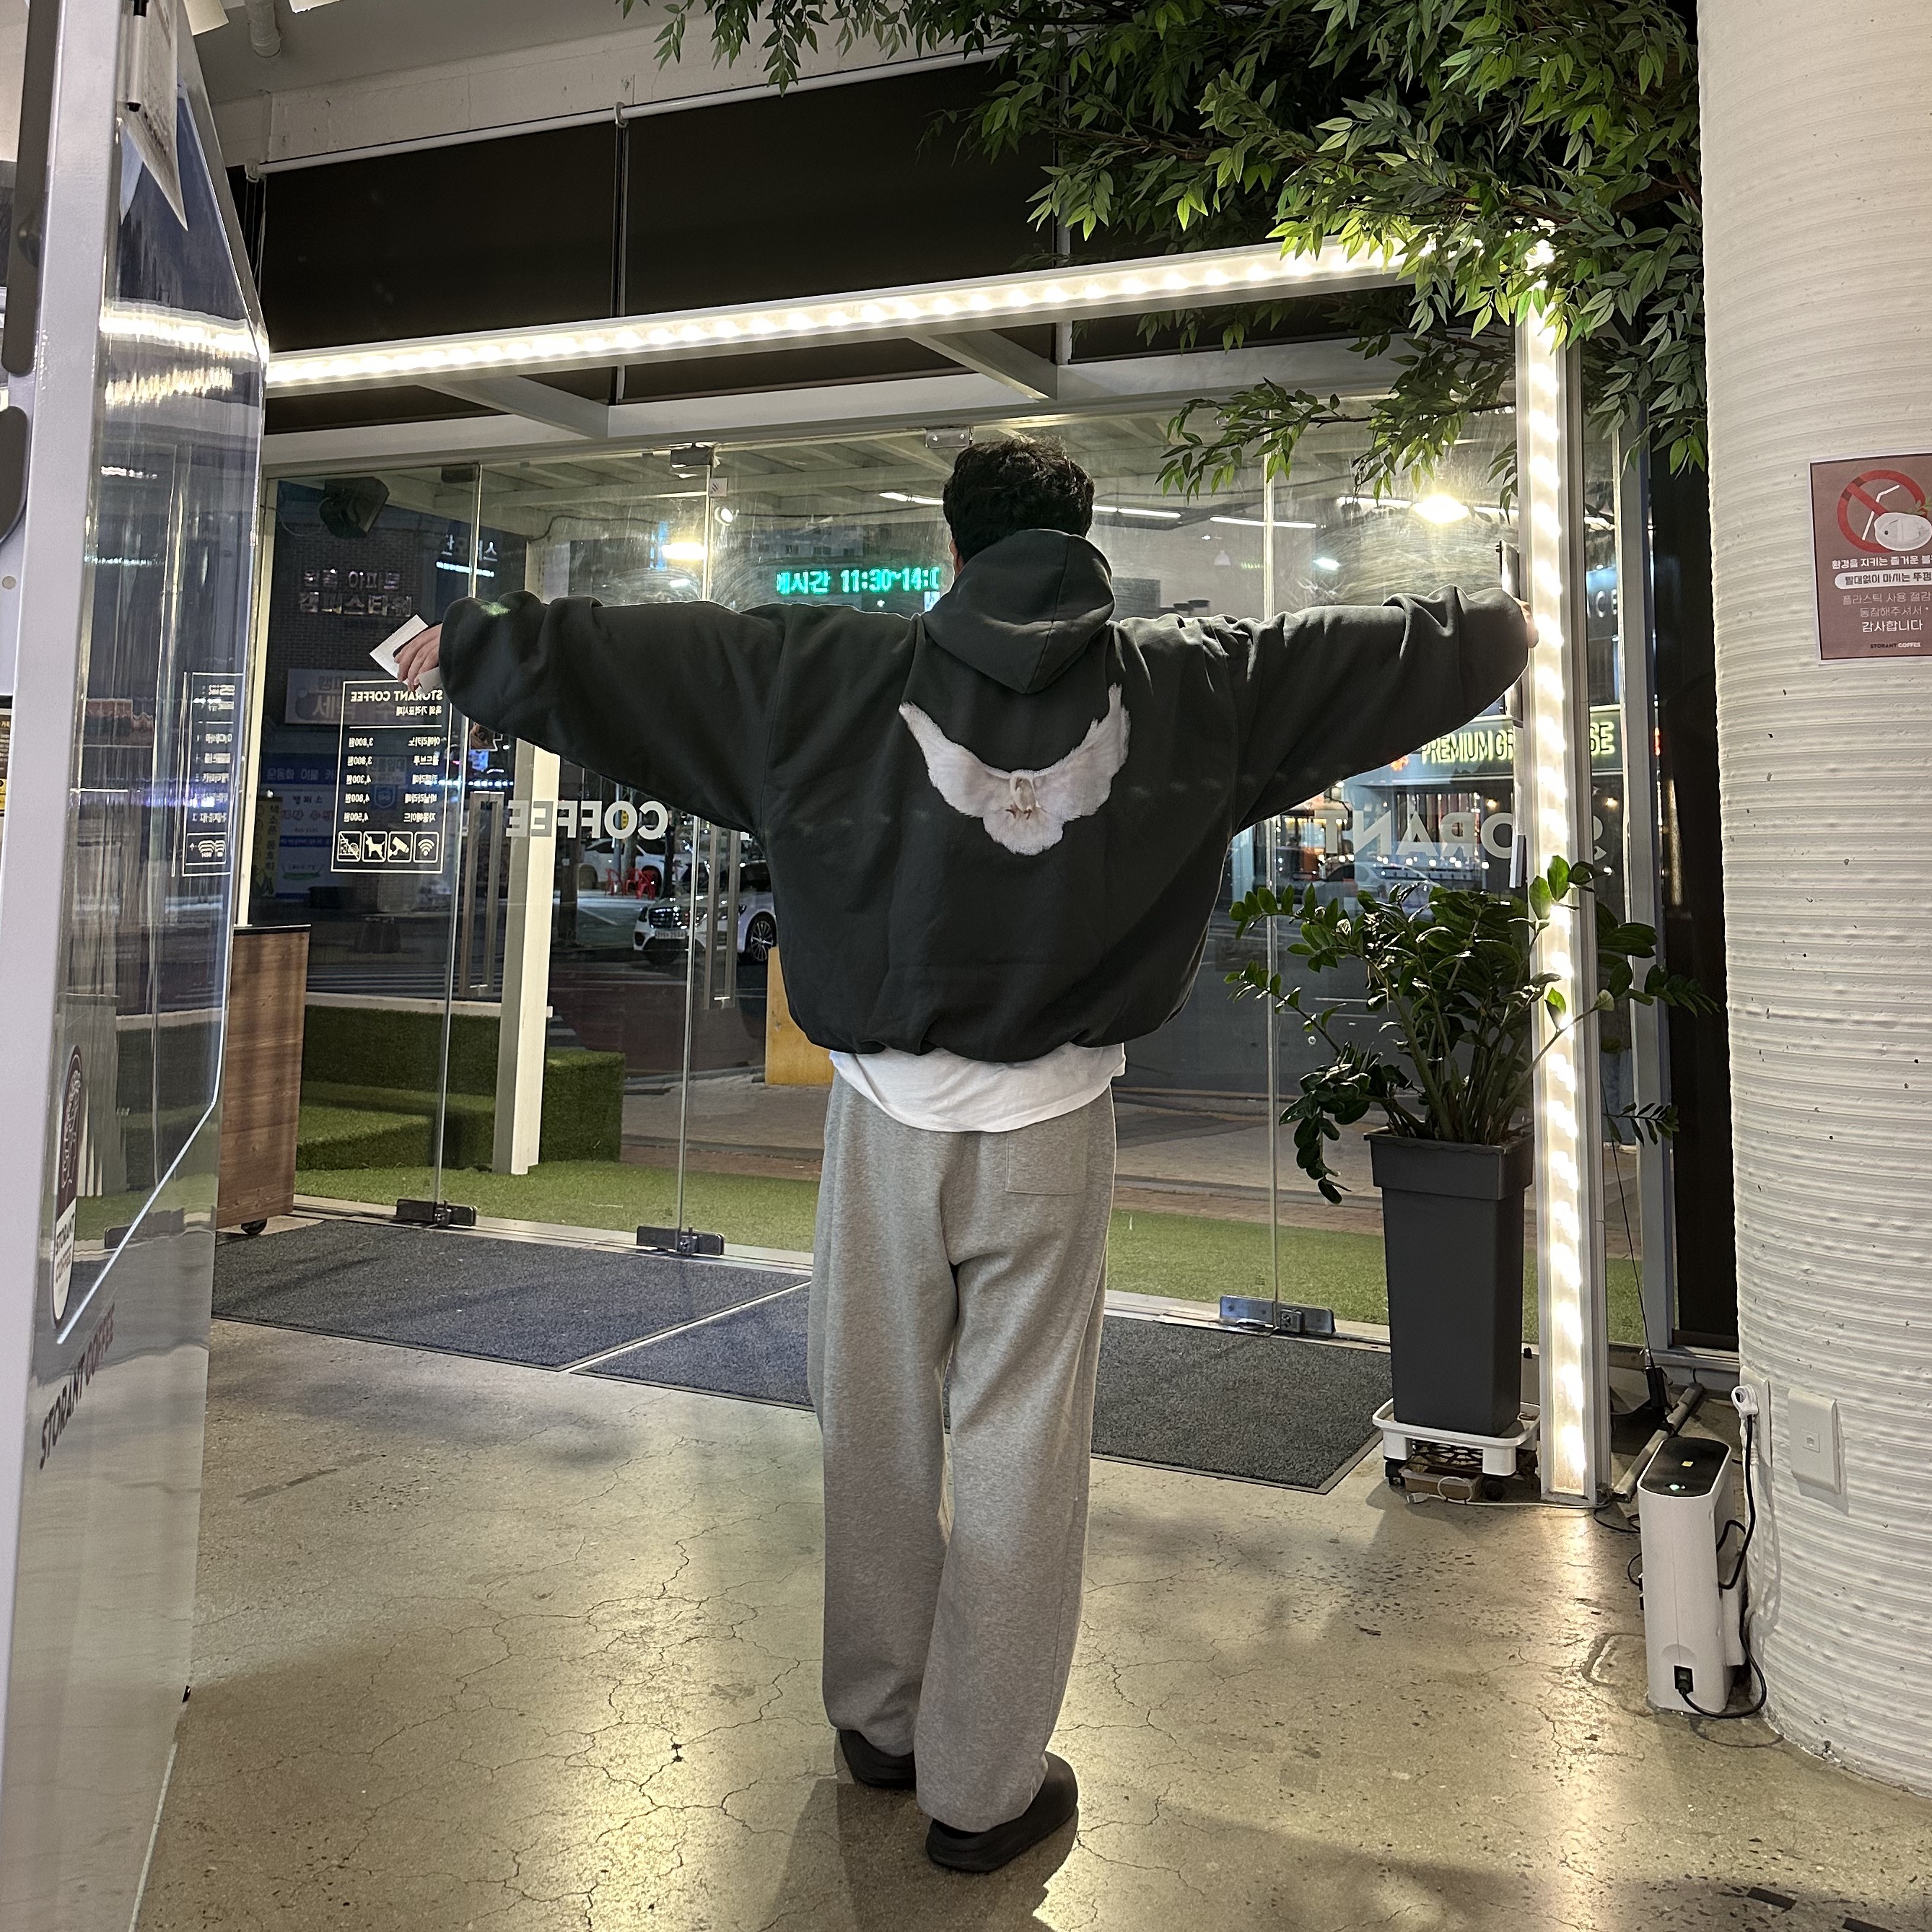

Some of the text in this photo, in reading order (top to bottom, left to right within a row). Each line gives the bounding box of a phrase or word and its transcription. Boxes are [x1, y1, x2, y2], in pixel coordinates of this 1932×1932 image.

[1860, 556, 1888, 567] 지키는
[1890, 555, 1919, 566] 즐거운
[1883, 572, 1911, 582] 마시는
[1843, 593, 1882, 606] 플라스틱
[1886, 592, 1907, 603] 사용
[1860, 606, 1922, 618] 동참해주셔서
[1861, 618, 1923, 633] 감사합니다
[1421, 730, 1494, 764] PREMIUM
